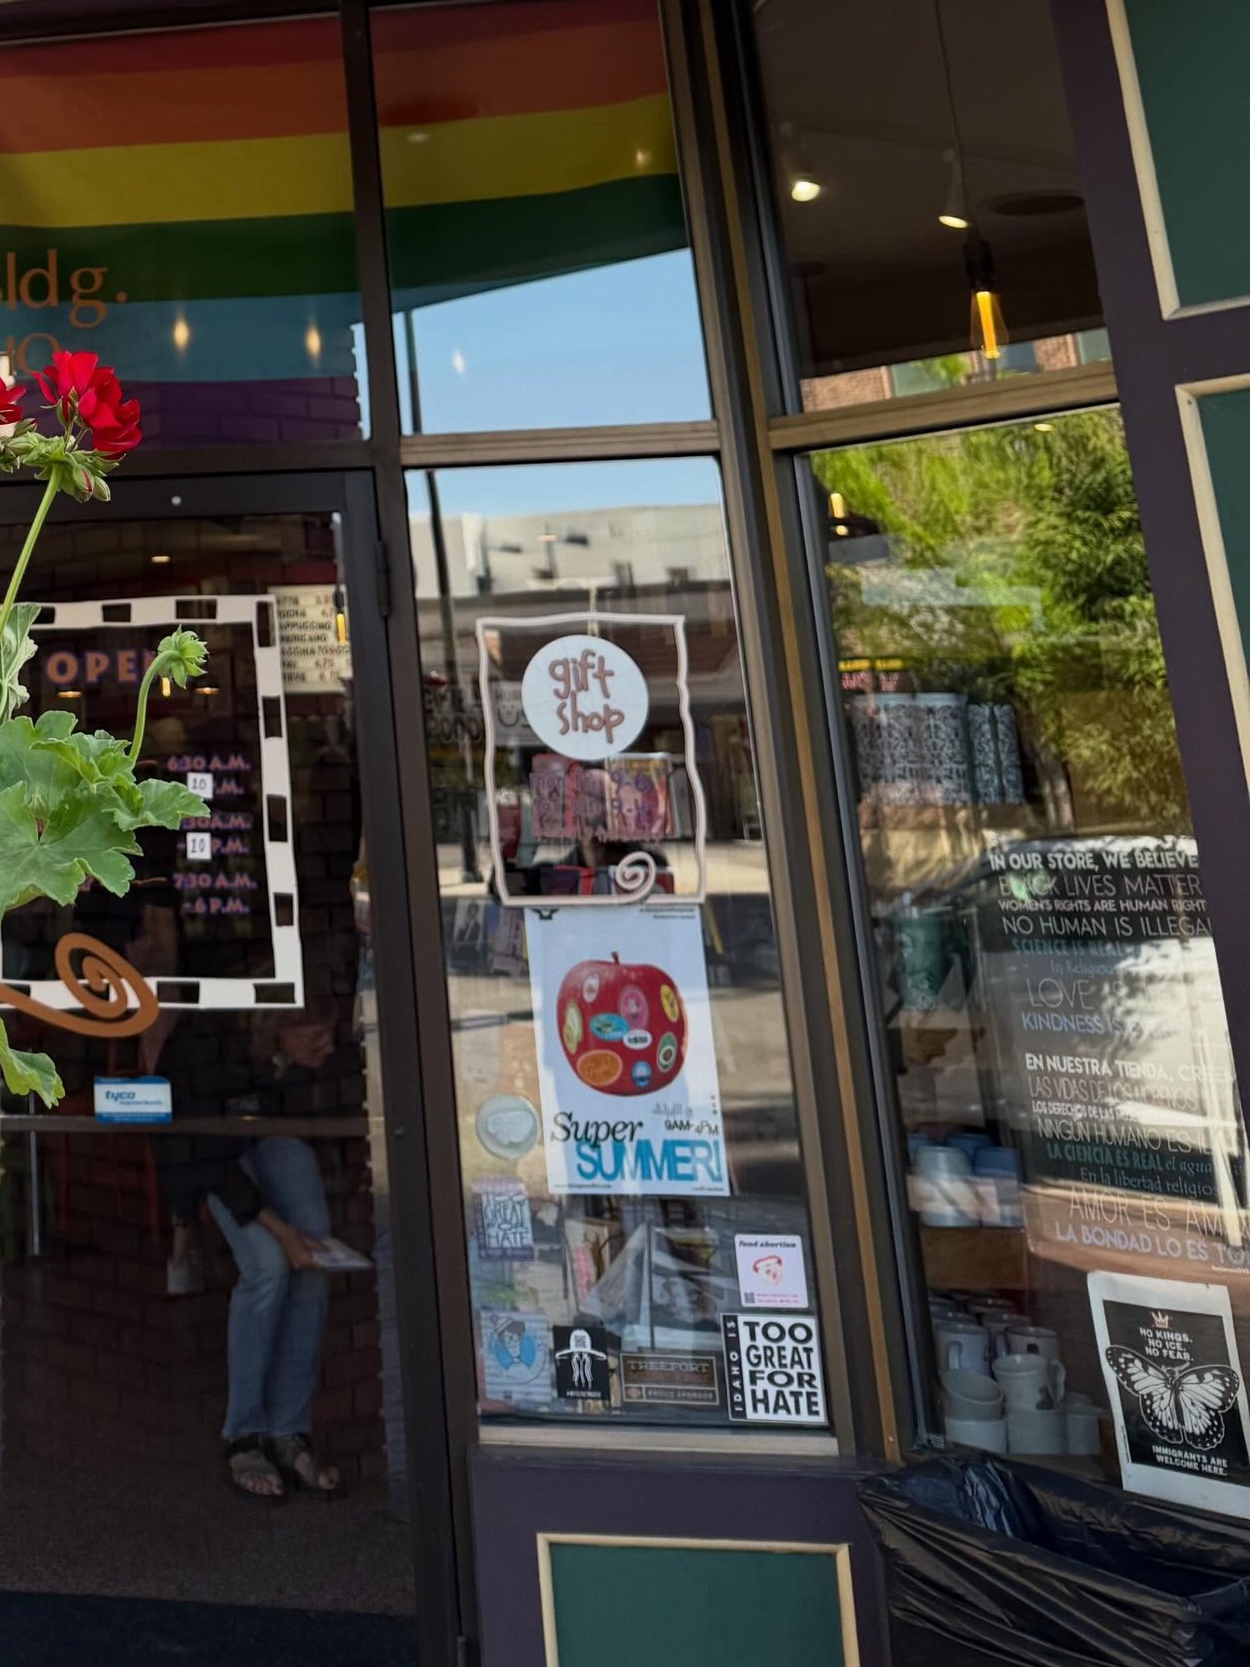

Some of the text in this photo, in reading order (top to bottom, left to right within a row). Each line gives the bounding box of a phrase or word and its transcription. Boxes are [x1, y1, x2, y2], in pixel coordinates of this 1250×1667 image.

[549, 649, 614, 699] gift
[556, 689, 625, 744] shop
[167, 754, 250, 771] 6:30 A.M.
[215, 779, 244, 794] .M.
[182, 813, 252, 830] :30 A.M.
[990, 851, 1199, 872] IN OUR STORE, WE BELIEVE
[215, 873, 257, 889] A.M.
[999, 873, 1203, 897] BCK LIVES MATTER
[209, 897, 249, 913] P.M.
[1054, 899, 1091, 912] RIGHTS
[1094, 899, 1116, 912] ARE
[1119, 900, 1168, 912] HUMAN
[1001, 915, 1034, 935] NO
[1039, 916, 1107, 936] HUMAN
[1114, 917, 1133, 936] IS
[1026, 977, 1095, 1011] LOVE
[1021, 1012, 1101, 1034] KINDNESS
[1025, 1053, 1044, 1071] EN
[1047, 1054, 1112, 1076] NUESTRA
[105, 1090, 136, 1101] tyco
[1029, 1075, 1051, 1099] LAS
[551, 1111, 643, 1150] Super
[1047, 1142, 1062, 1159] LA
[1065, 1144, 1113, 1166] CIENCIA
[1116, 1149, 1130, 1167] ES
[1134, 1152, 1164, 1172] REAL
[1179, 1161, 1213, 1177] agua
[1080, 1167, 1097, 1183] En
[1101, 1168, 1112, 1184] la
[1115, 1170, 1162, 1193] libertad
[1069, 1185, 1132, 1226] AMOR
[1141, 1196, 1172, 1232] ES
[1054, 1222, 1078, 1244] LA
[1081, 1225, 1154, 1253] BONDAD
[1157, 1238, 1183, 1260] LO
[1187, 1240, 1209, 1261] ES
[743, 1321, 813, 1345] TOO
[1139, 1327, 1193, 1343] NO KINGS.
[1145, 1346, 1194, 1362] NO FEAR.
[1148, 1339, 1186, 1351] NO ICE.
[627, 1360, 710, 1373] TREEFORT
[726, 1320, 743, 1412] IDAHO IS
[746, 1344, 814, 1370] GREAT
[749, 1370, 818, 1389] FOR
[750, 1388, 821, 1416] HATE
[1152, 1445, 1228, 1468] IMMIGRANTS ARE
[1155, 1454, 1199, 1471] WELCOME
